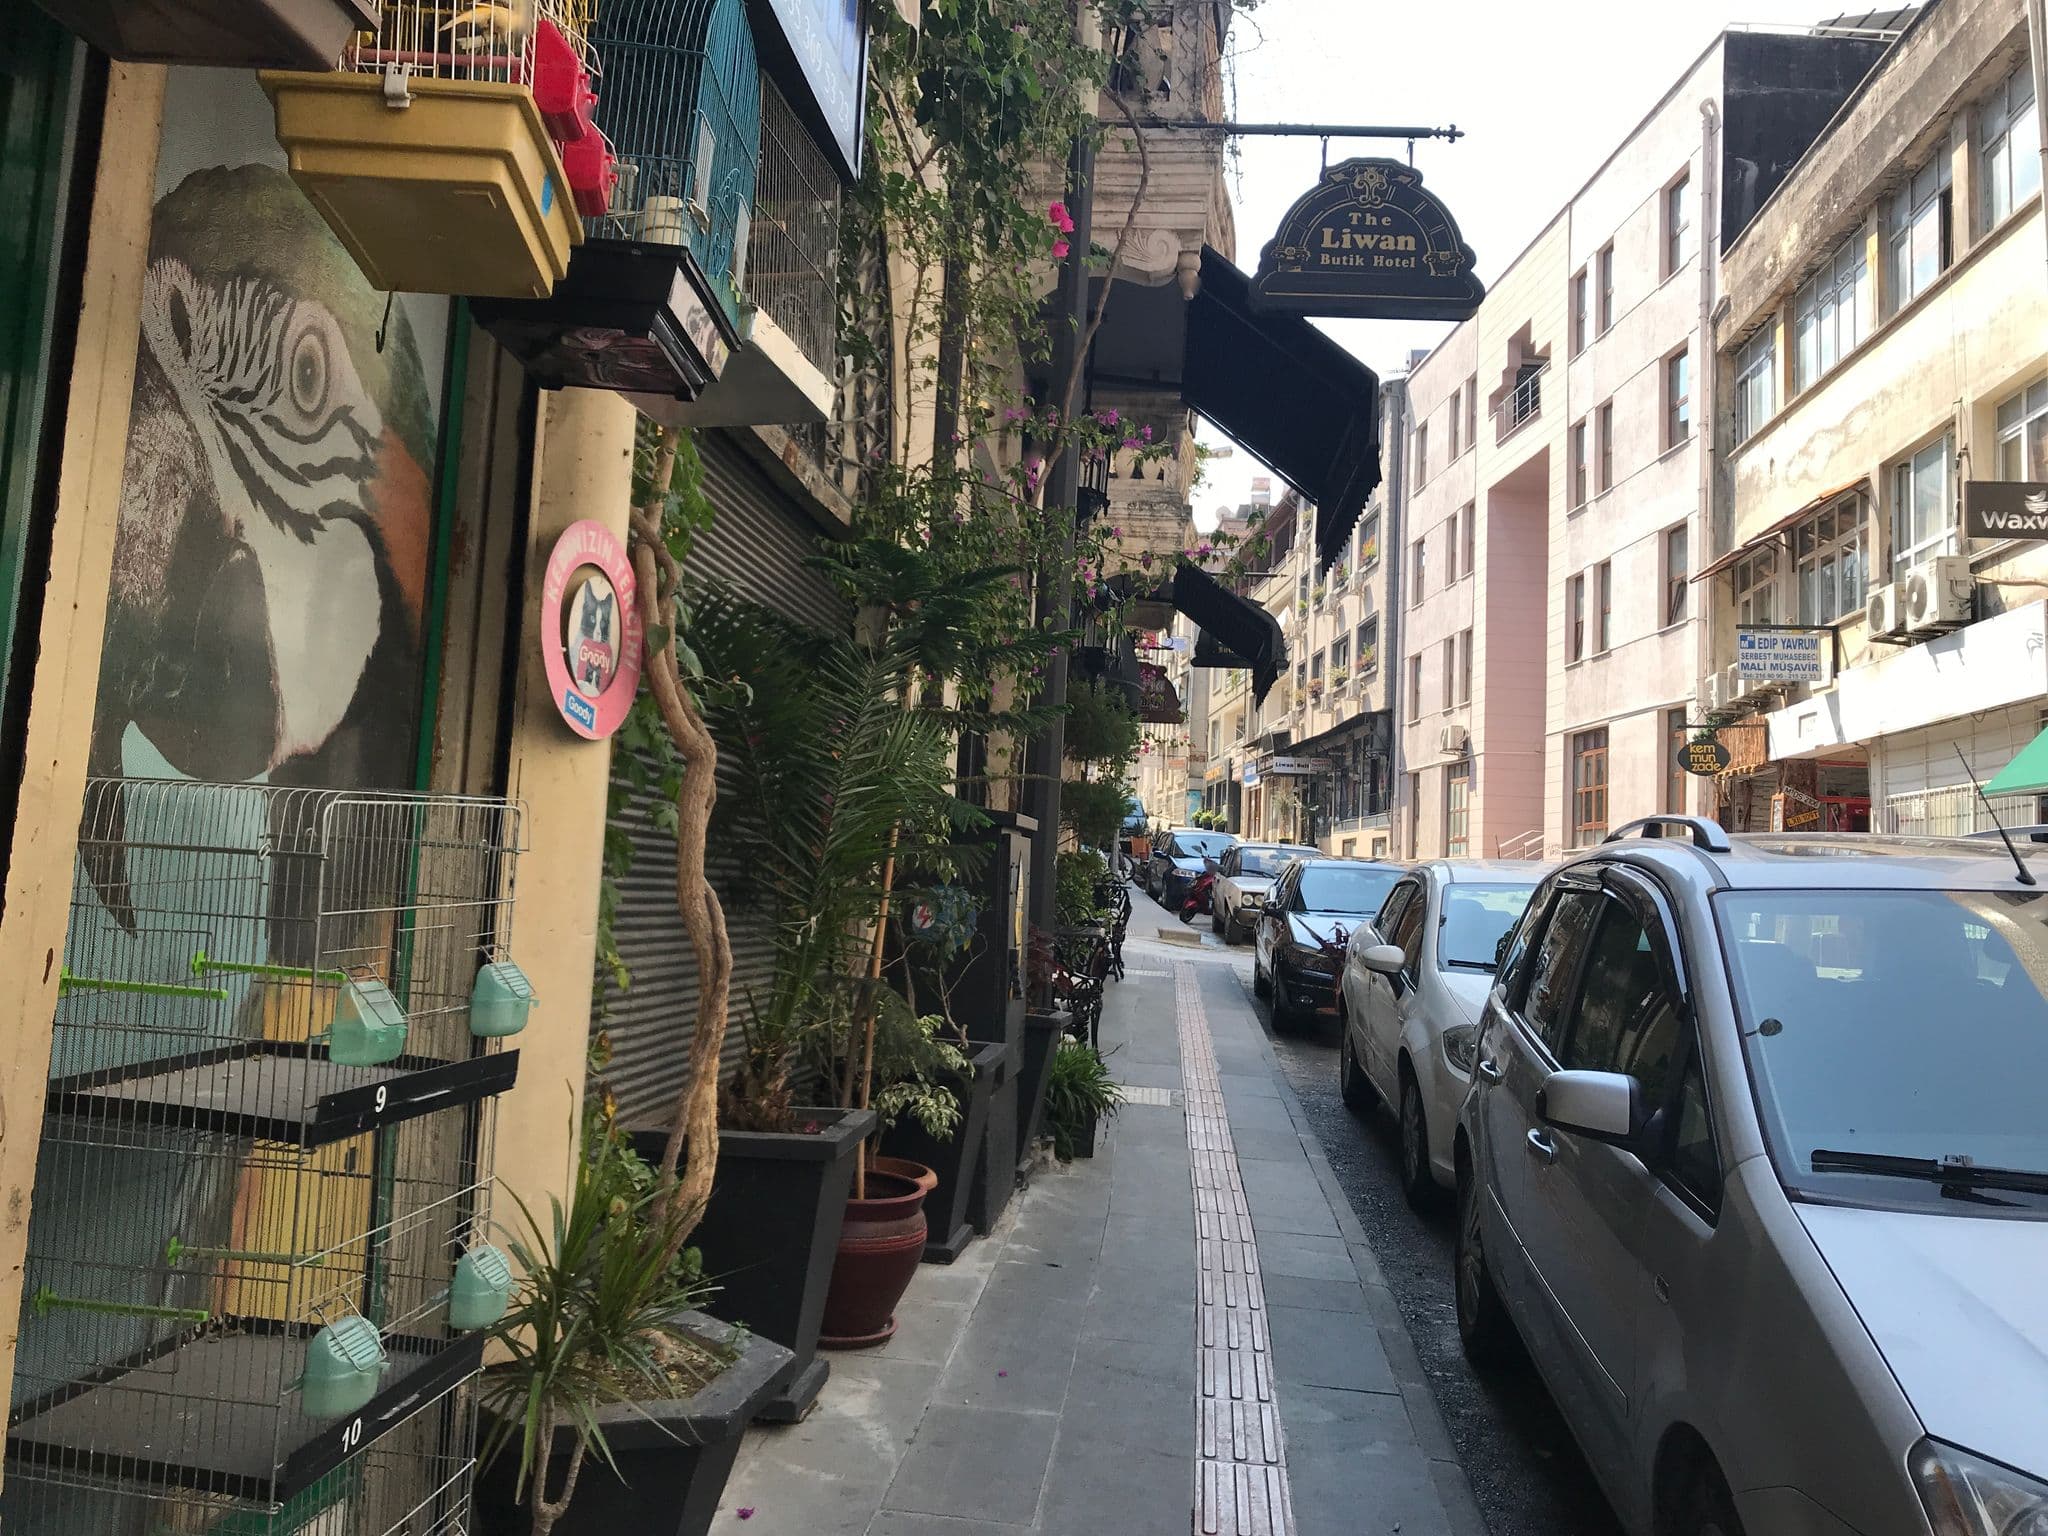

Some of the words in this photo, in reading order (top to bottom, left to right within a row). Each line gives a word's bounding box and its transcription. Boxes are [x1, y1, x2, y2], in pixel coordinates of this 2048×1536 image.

[1349, 212, 1392, 226] The
[1321, 227, 1417, 251] Liwan
[1320, 253, 1365, 266] Butik
[1373, 255, 1416, 268] Hotel
[1757, 635, 1778, 650] EDİP
[1780, 638, 1818, 650] YAVRUM
[580, 645, 610, 674] Goody
[1740, 652, 1771, 660] SERBEST
[568, 695, 592, 725] Goody
[1690, 744, 1715, 753] kem
[1690, 754, 1716, 762] mun
[1692, 762, 1721, 772] zade
[374, 1085, 387, 1113] 9
[342, 1417, 362, 1453] 10
